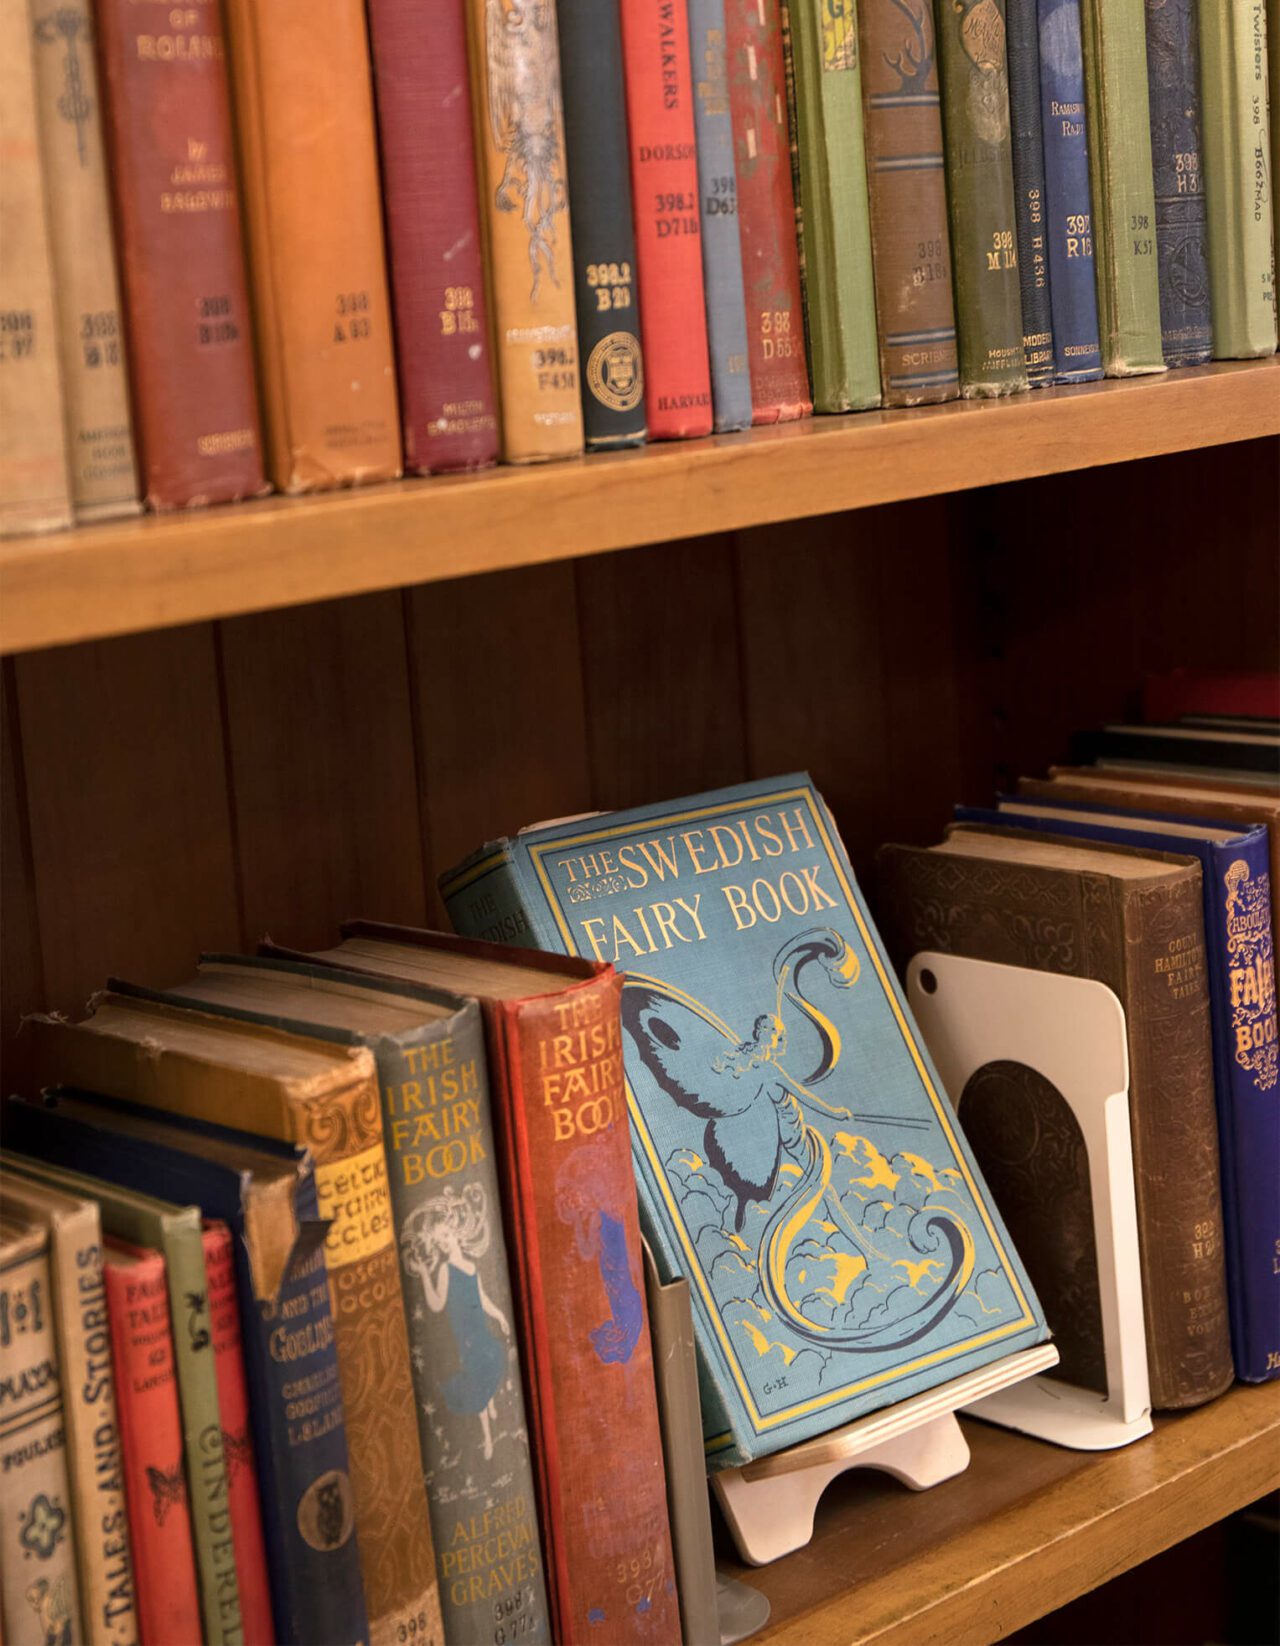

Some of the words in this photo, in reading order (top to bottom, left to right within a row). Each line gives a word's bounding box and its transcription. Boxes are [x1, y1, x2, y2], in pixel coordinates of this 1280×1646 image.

[558, 854, 620, 883] THE
[617, 808, 815, 889] SWEDISH
[581, 894, 707, 963] FAIRY
[721, 865, 839, 931] BOOK
[386, 1059, 478, 1116] IRISH
[403, 1039, 455, 1075] THE
[391, 1097, 481, 1150] FAIRY
[402, 1129, 487, 1186] BOOK
[77, 1246, 110, 1405] STORIES
[94, 1422, 123, 1492] AND
[101, 1507, 134, 1630] TALES
